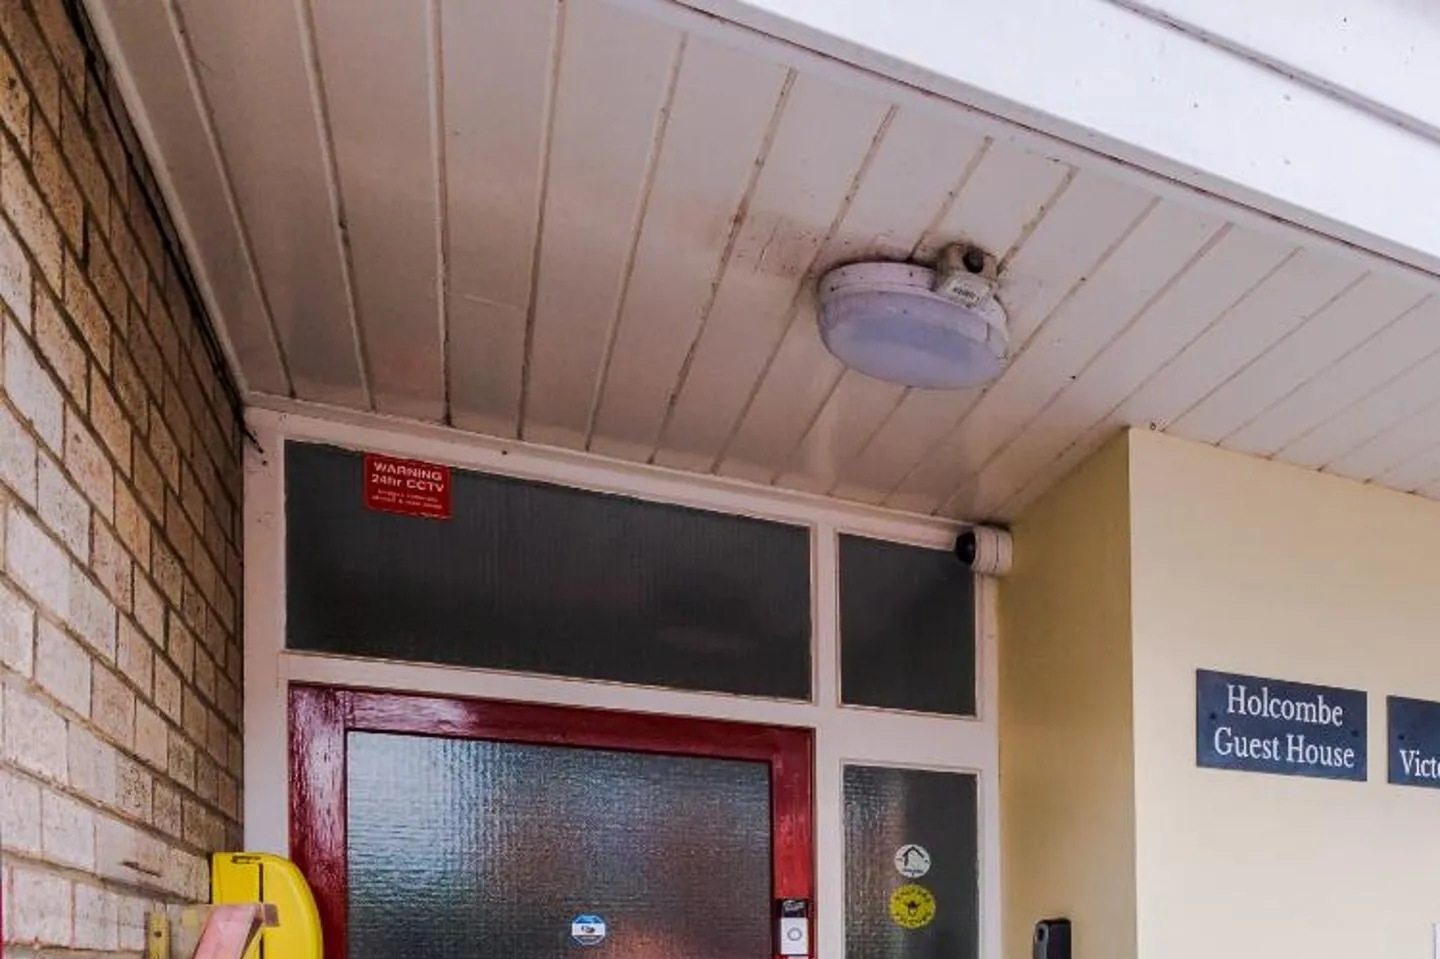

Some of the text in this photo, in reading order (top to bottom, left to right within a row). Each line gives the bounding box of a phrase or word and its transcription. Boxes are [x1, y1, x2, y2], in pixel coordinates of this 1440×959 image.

[371, 474, 444, 492] 24hr CCTV
[373, 462, 442, 480] WARNING
[1227, 683, 1343, 726] Holcombe
[1214, 727, 1354, 768] Guest House
